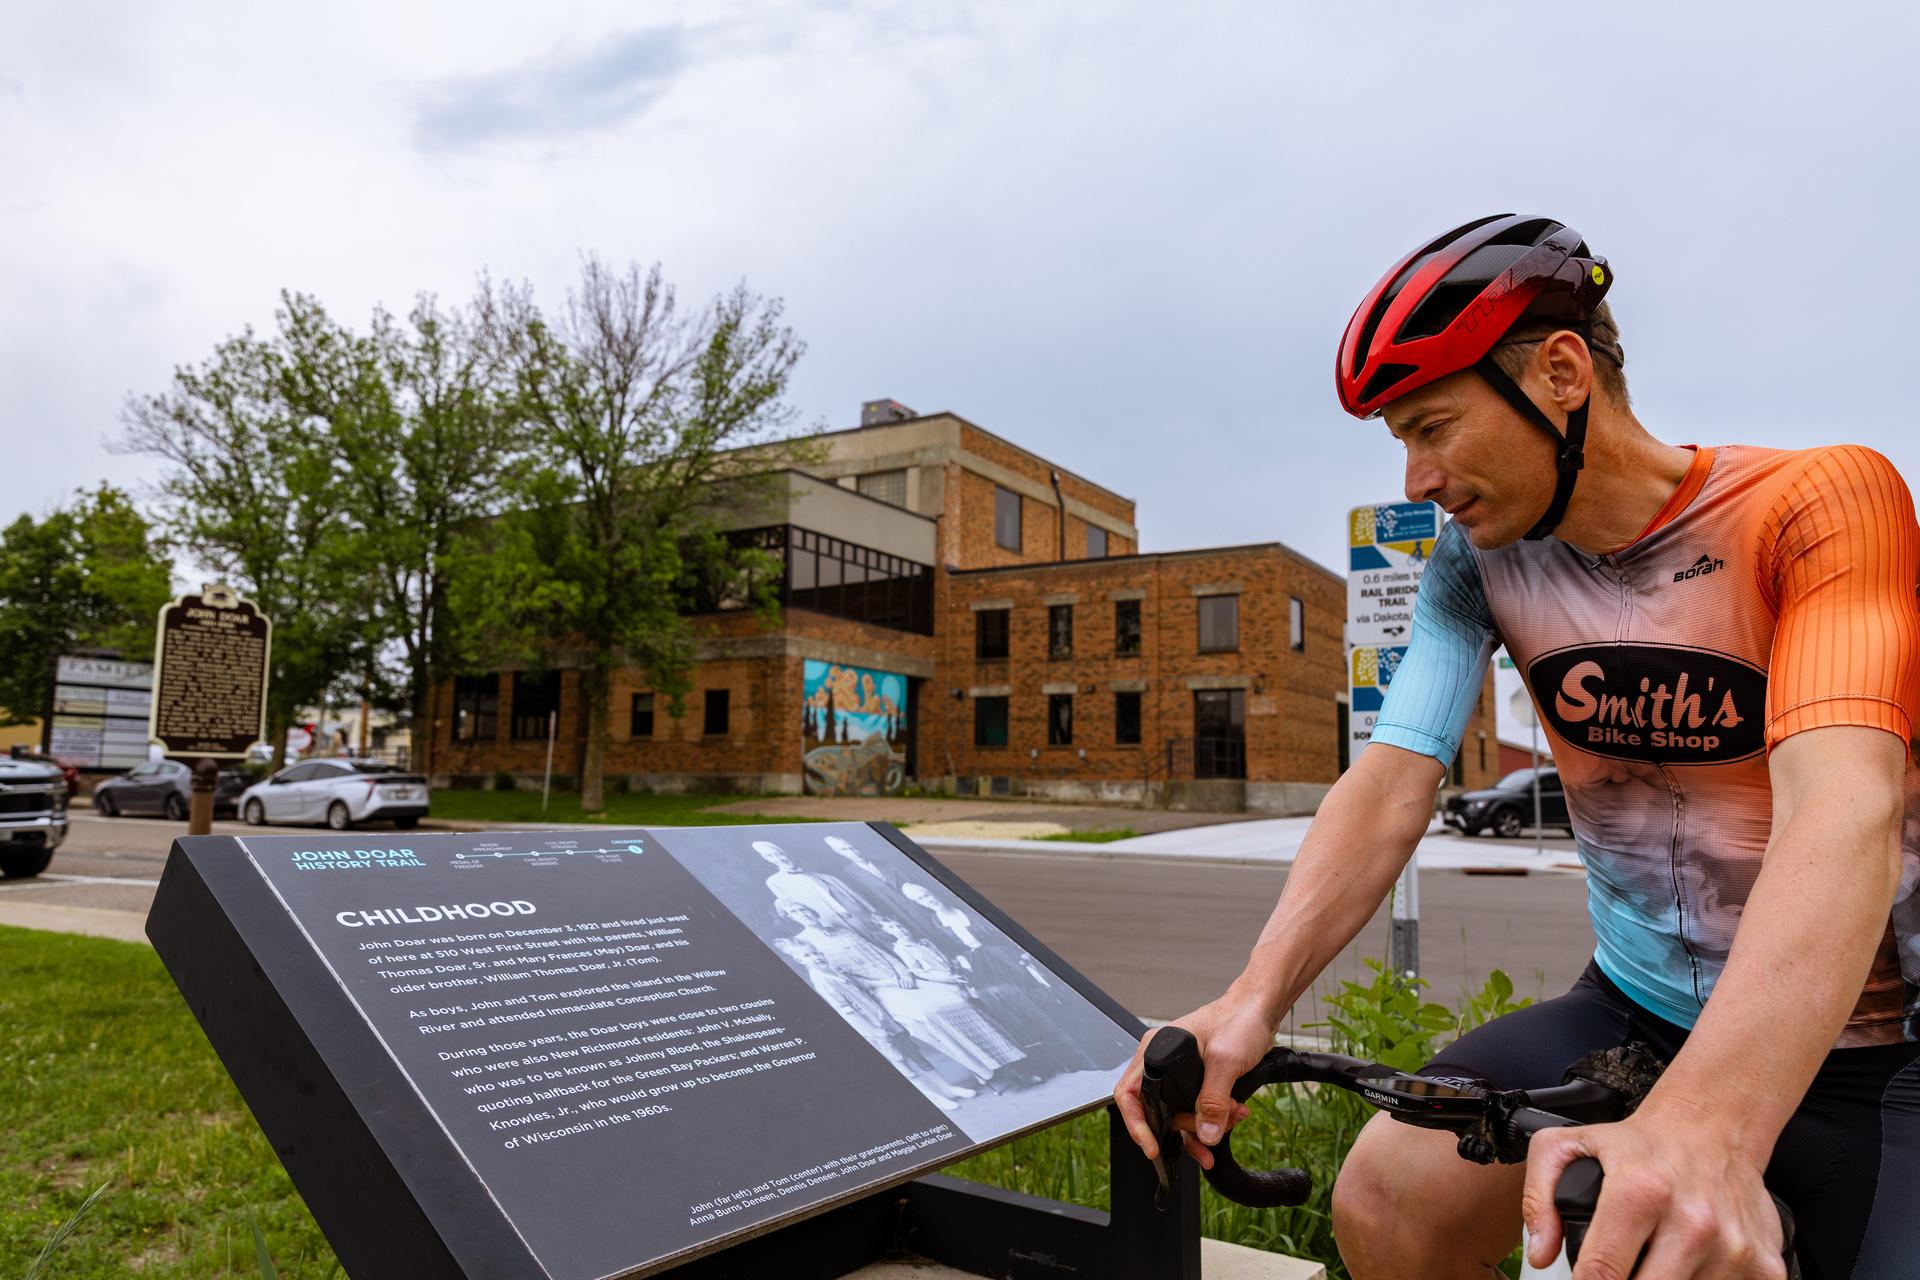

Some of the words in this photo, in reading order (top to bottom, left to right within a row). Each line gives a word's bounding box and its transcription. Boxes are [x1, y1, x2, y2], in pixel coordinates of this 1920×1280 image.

[1360, 588, 1382, 598] RAIL
[1387, 585, 1418, 596] BRIDG
[1364, 574, 1380, 584] 0.6
[1383, 572, 1410, 583] miles
[1413, 572, 1422, 580] to
[1356, 615, 1370, 624] via
[1379, 597, 1407, 607] TRAIL
[1555, 660, 1744, 729] Smith's
[1588, 726, 1641, 745] Bike
[1651, 731, 1720, 752] Shop
[291, 851, 351, 860] JOHN
[354, 848, 416, 859] DOAR
[296, 860, 372, 870] HISTORY
[376, 859, 426, 867] TRAIL
[336, 900, 536, 928] CHILDHOOD
[359, 942, 392, 951] John
[394, 938, 426, 948] Doar
[429, 936, 455, 945] was
[456, 932, 486, 942] born
[505, 925, 562, 938] December
[576, 922, 600, 931] 1921
[601, 920, 621, 929] and
[620, 918, 646, 927] lived
[647, 916, 666, 925] just
[666, 914, 690, 922] west
[368, 956, 383, 965] of
[387, 952, 416, 962] here
[420, 951, 434, 960] at
[435, 950, 458, 958] 510
[460, 946, 495, 956] West
[493, 942, 524, 952] First
[524, 940, 561, 950] Street
[562, 936, 586, 946] with
[586, 935, 604, 944] his
[604, 931, 646, 944] parents,
[646, 928, 684, 937] William
[377, 968, 434, 980] Thomas
[435, 964, 472, 974] Doar,
[472, 960, 490, 970] Sr.
[493, 958, 516, 967] and
[516, 954, 546, 965] Mary
[548, 950, 592, 960] Frances
[594, 946, 625, 956] (May)
[625, 942, 655, 953] Doar,
[655, 940, 674, 950] and
[674, 938, 690, 947] his
[390, 982, 426, 994] older
[428, 976, 484, 990] brother,
[483, 970, 531, 984] William
[531, 966, 578, 978] Thomas
[580, 963, 610, 972] Doar,
[612, 960, 626, 968] Jr.
[626, 956, 662, 966] (Tom).
[410, 1010, 428, 1018] As
[428, 1004, 468, 1017] boys,
[470, 1000, 502, 1011] John
[504, 996, 529, 1006] and
[529, 992, 558, 1002] Tom
[560, 984, 610, 999] explored
[611, 982, 630, 991] the
[631, 978, 662, 988] island
[663, 976, 675, 984] in
[675, 974, 693, 982] the
[692, 968, 726, 979] Willow
[419, 1022, 456, 1034] River
[460, 1018, 486, 1029] and
[488, 1009, 546, 1025] attended
[547, 999, 615, 1016] Immaculate
[615, 990, 678, 1006] Conception
[677, 984, 717, 996] Church.
[438, 1046, 488, 1061] During
[489, 1040, 528, 1052] those
[528, 1033, 568, 1048] years,
[568, 1029, 589, 1039] the
[589, 1024, 619, 1036] Doar
[619, 1020, 650, 1032] boys
[650, 1016, 678, 1026] were
[678, 1010, 706, 1021] close
[705, 1008, 719, 1016] to
[718, 1004, 740, 1014] two
[740, 998, 776, 1010] cousins
[451, 1066, 482, 1078] who
[485, 1060, 520, 1072] were
[522, 1054, 550, 1066] also
[550, 1048, 580, 1060] New
[580, 1036, 640, 1054] Richmond
[642, 1028, 695, 1043] residents:
[696, 1022, 722, 1034] John
[722, 1020, 734, 1028] V.
[733, 1013, 776, 1028] McNally,
[463, 1082, 496, 1095] who
[497, 1077, 526, 1088] was
[526, 1074, 543, 1083] to
[543, 1069, 563, 1080] be
[563, 1062, 607, 1076] known
[608, 1059, 622, 1068] as
[625, 1052, 666, 1065] Johnny
[666, 1042, 704, 1056] Blood,
[702, 1039, 722, 1048] the
[722, 1026, 786, 1045] Shakespeare-
[477, 1094, 534, 1114] quoting
[534, 1084, 592, 1100] halfback
[592, 1079, 611, 1090] for
[612, 1074, 634, 1085] the
[635, 1068, 671, 1080] Green
[670, 1062, 694, 1073] Bay
[695, 1052, 740, 1068] Packers;
[740, 1048, 760, 1058] and
[758, 1040, 796, 1052] Warren
[489, 1111, 556, 1131] Knowles,
[556, 1106, 579, 1117] Jr.,
[578, 1099, 608, 1112] who
[608, 1089, 648, 1104] would
[648, 1083, 680, 1097] grow
[680, 1080, 696, 1089] up
[696, 1076, 710, 1085] to
[710, 1066, 754, 1082] become
[753, 1062, 772, 1072] the
[772, 1052, 816, 1068] Governor
[1364, 1088, 1398, 1105] GARMIN
[504, 1138, 520, 1150] of
[521, 1122, 594, 1146] Wisconsin
[594, 1118, 609, 1128] in
[608, 1112, 632, 1124] the
[632, 1103, 672, 1120] 1960s.
[689, 1213, 716, 1226] Anna
[714, 1204, 742, 1218] Burns
[742, 1193, 780, 1208] Deneen,
[778, 1182, 808, 1196] Dennis
[806, 1170, 841, 1186] Deneen,
[840, 1164, 859, 1176] John
[858, 1158, 877, 1169] Doar
[878, 1152, 892, 1162] and
[890, 1144, 917, 1158] Maggie
[916, 1136, 938, 1148] Larkin
[937, 1130, 956, 1142] Doar.
[690, 1202, 714, 1214] John
[714, 1195, 732, 1206] (far
[731, 1188, 752, 1200] left)
[752, 1183, 770, 1194] and
[768, 1177, 790, 1188] Tom
[790, 1166, 823, 1182] (center)
[822, 1160, 841, 1170] with
[840, 1155, 858, 1164] their
[858, 1139, 908, 1160] grandparents,
[906, 1132, 922, 1142] (left
[928, 1124, 948, 1136] right)
